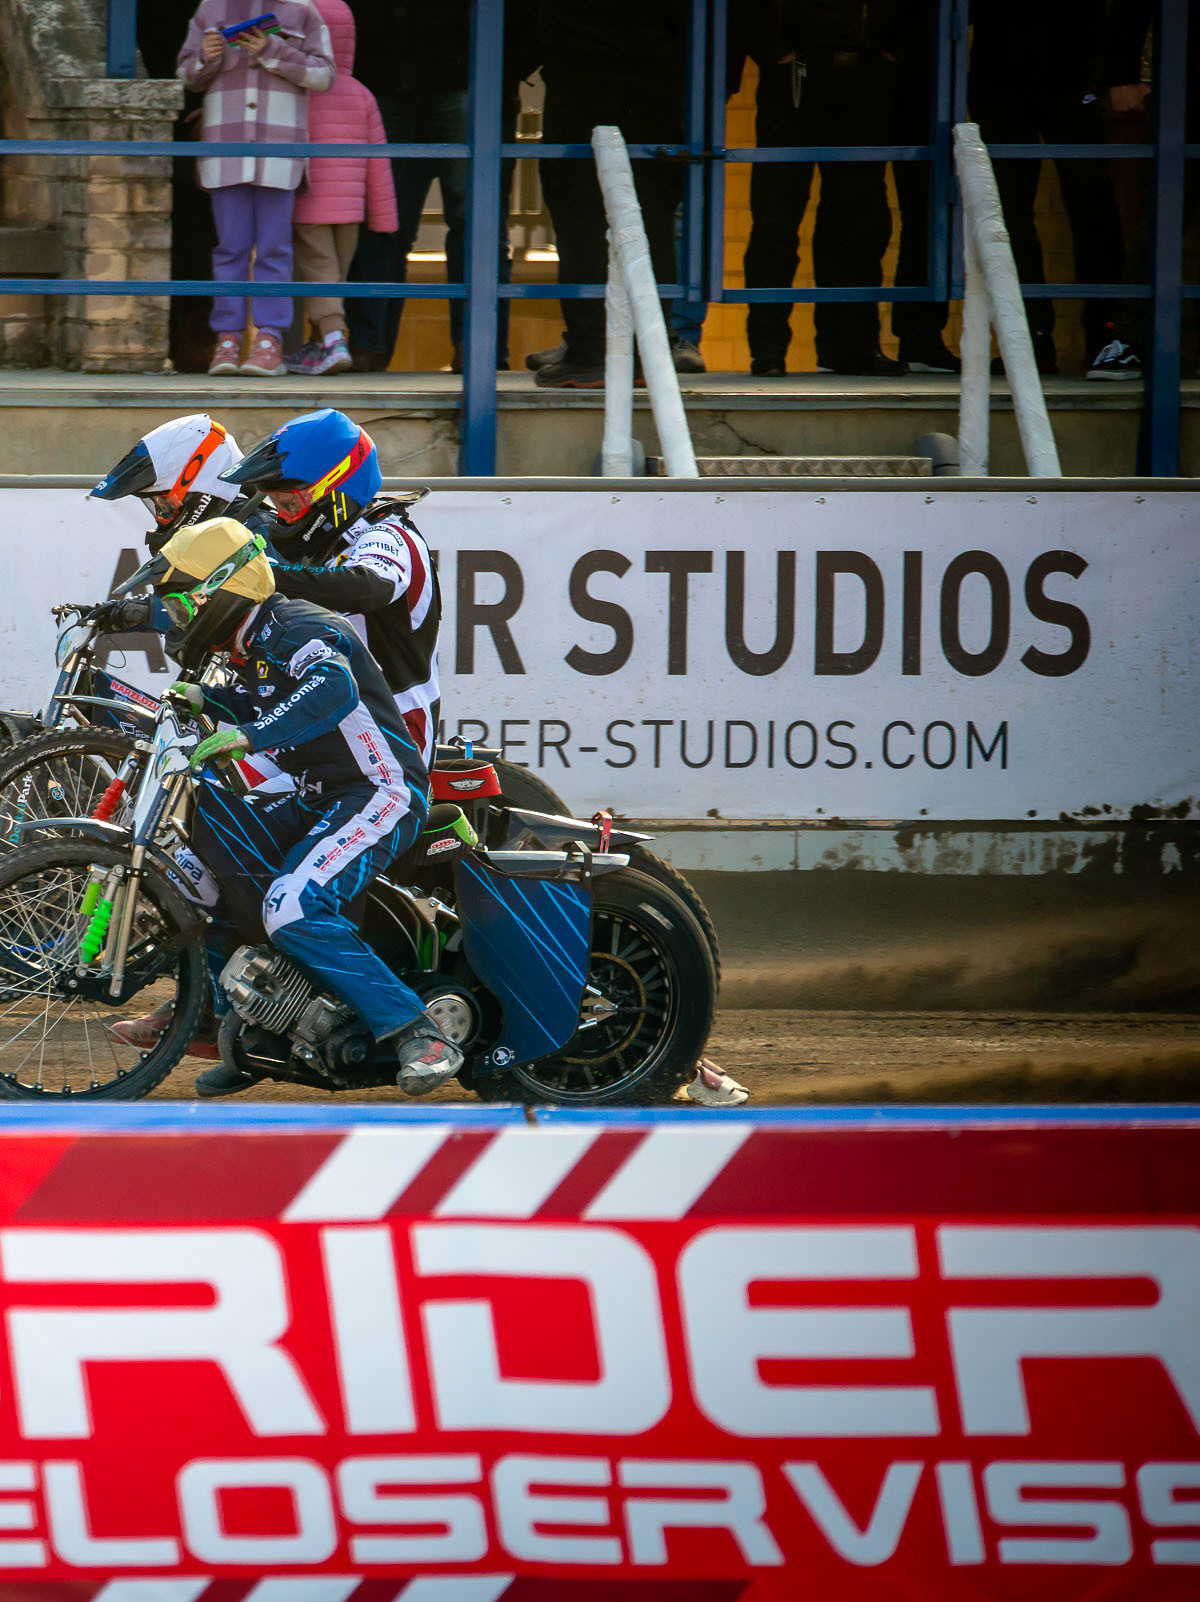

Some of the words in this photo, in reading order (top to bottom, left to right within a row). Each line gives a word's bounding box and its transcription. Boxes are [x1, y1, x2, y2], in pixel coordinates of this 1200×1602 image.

[358, 541, 399, 557] OPTIBET
[564, 549, 1092, 677] STUDIOS
[439, 719, 1009, 771] BER-STUDIOS.COM
